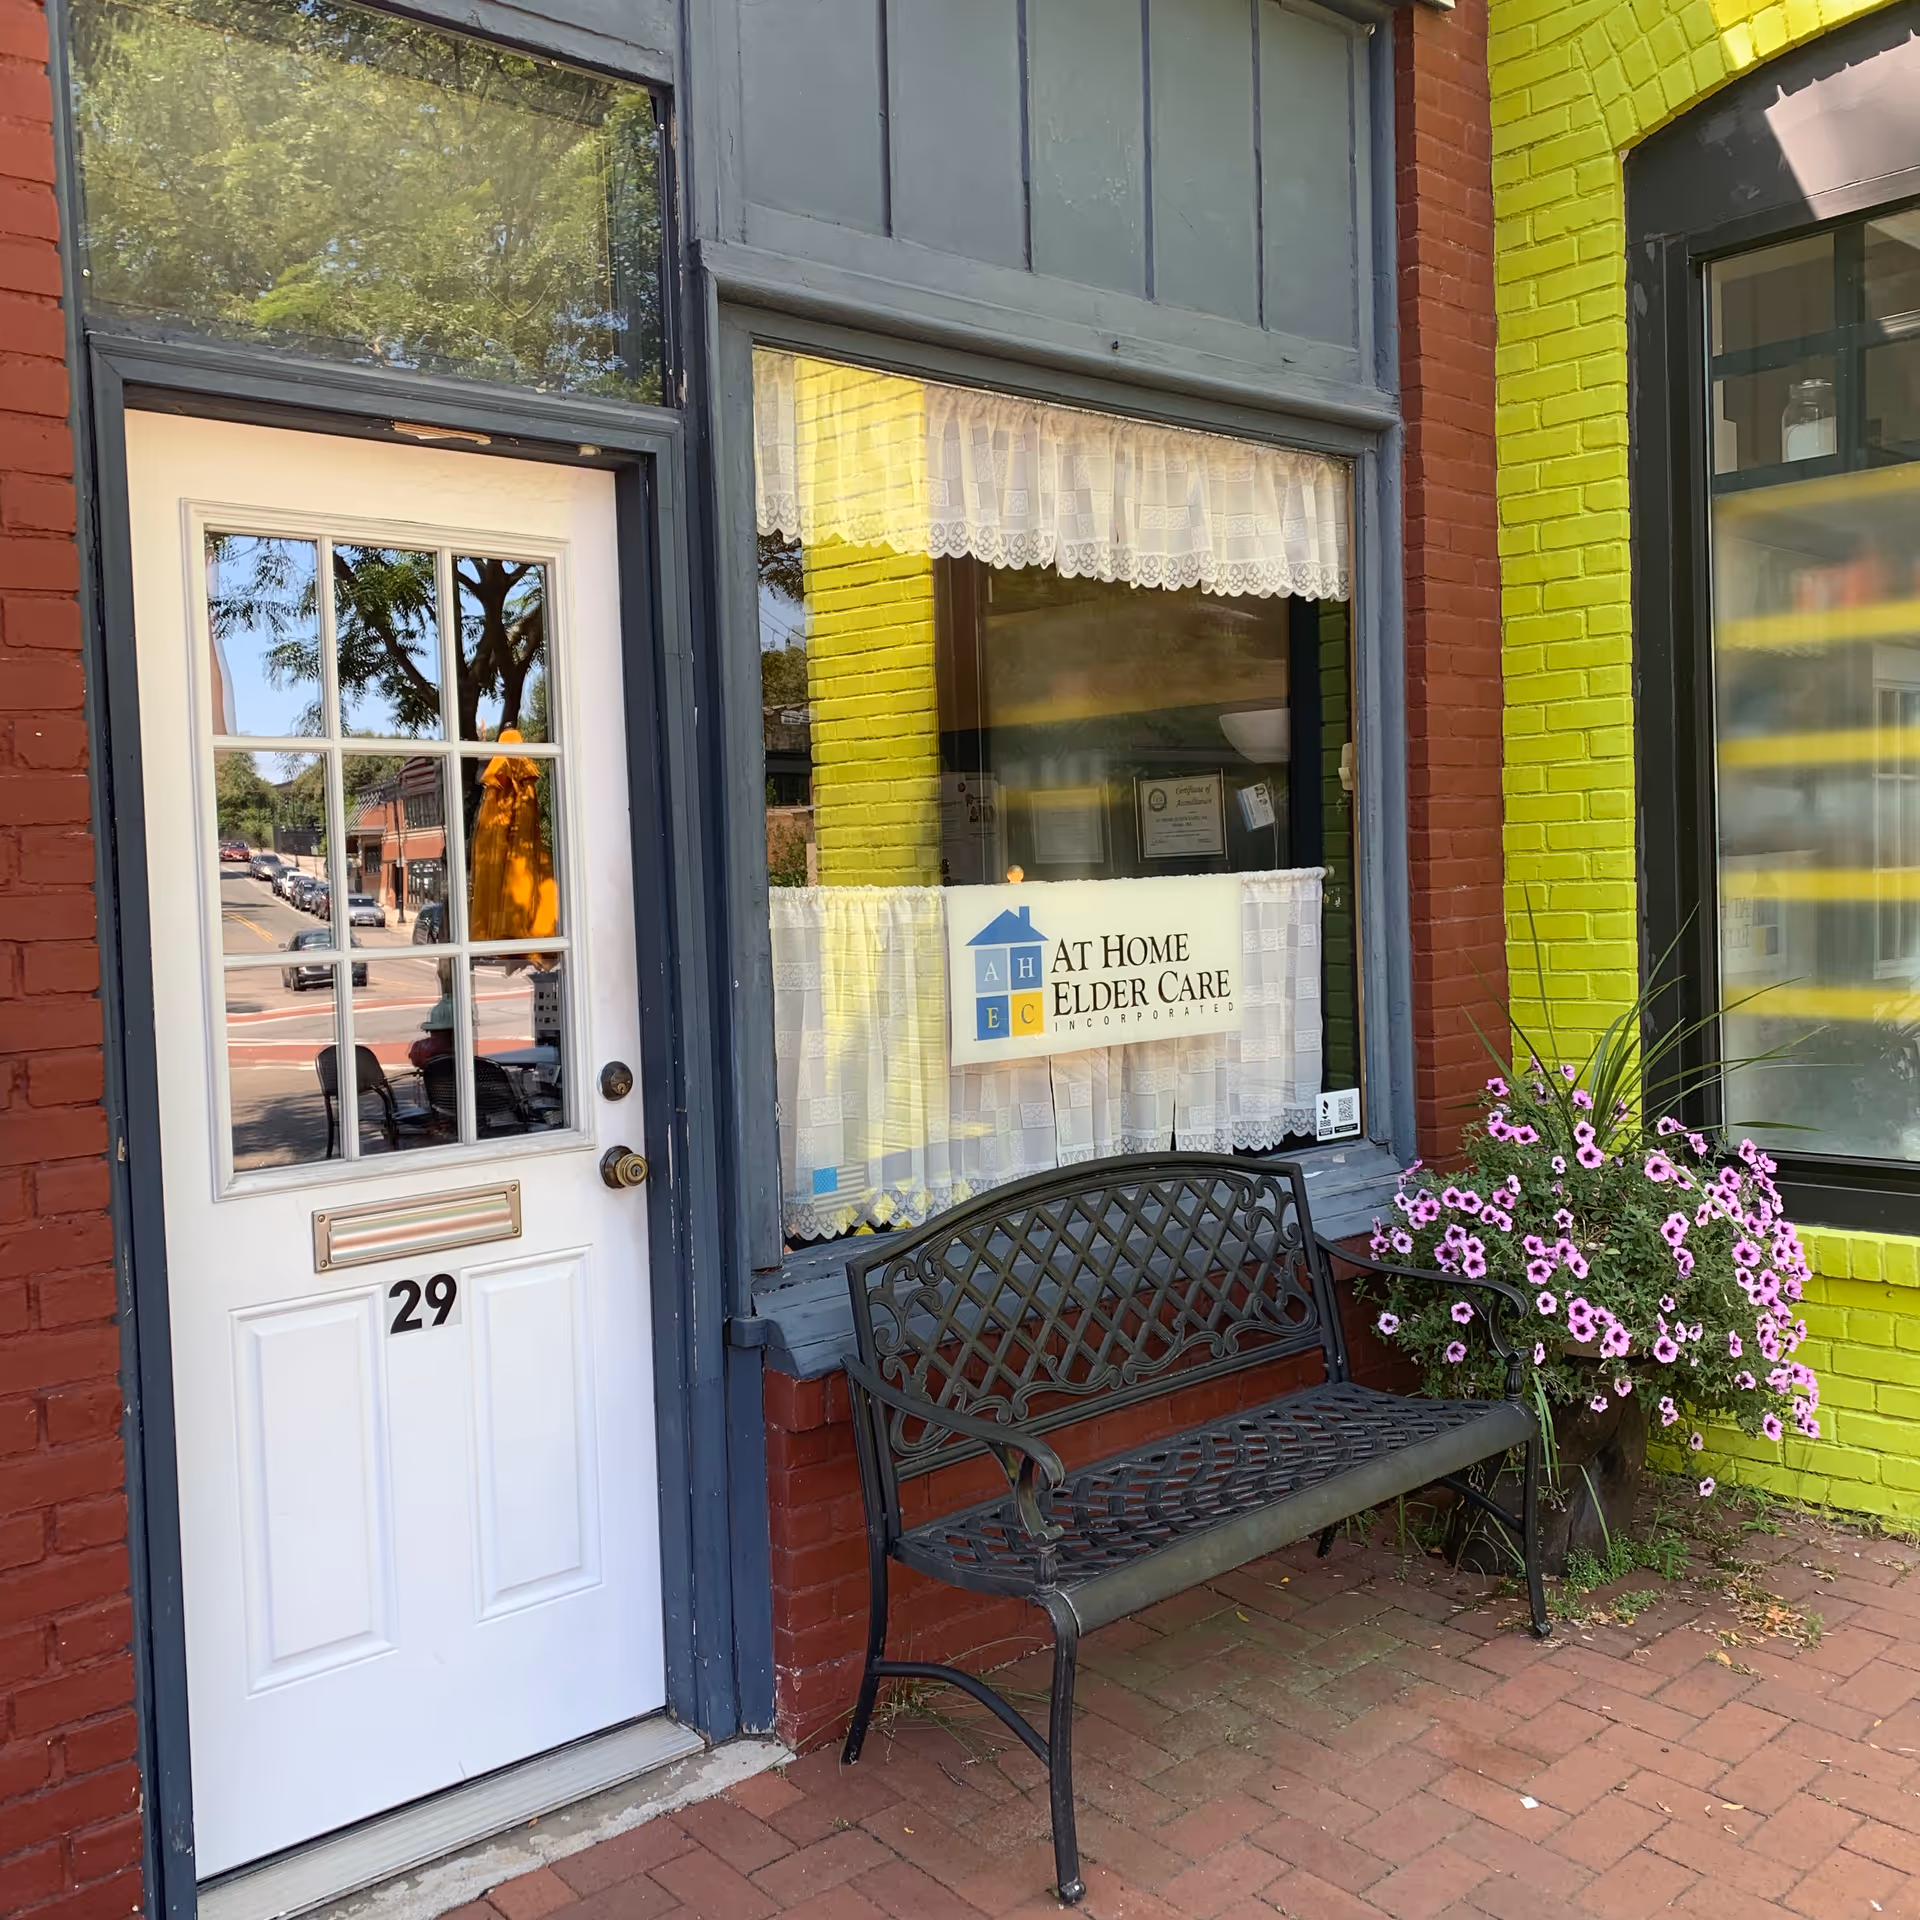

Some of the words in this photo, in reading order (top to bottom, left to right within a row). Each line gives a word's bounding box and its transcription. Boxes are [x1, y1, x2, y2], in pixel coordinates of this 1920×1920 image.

[984, 961, 999, 982] A
[1017, 957, 1034, 979] H
[1050, 938, 1092, 974] AT
[1100, 933, 1190, 968] HOME
[1051, 978, 1149, 1016] ELDER
[1158, 970, 1231, 1004] CARE
[986, 1007, 1000, 1028] E
[1021, 1004, 1035, 1024] C
[1055, 1002, 1234, 1031] INCORPORATED
[388, 1273, 457, 1335] 29
